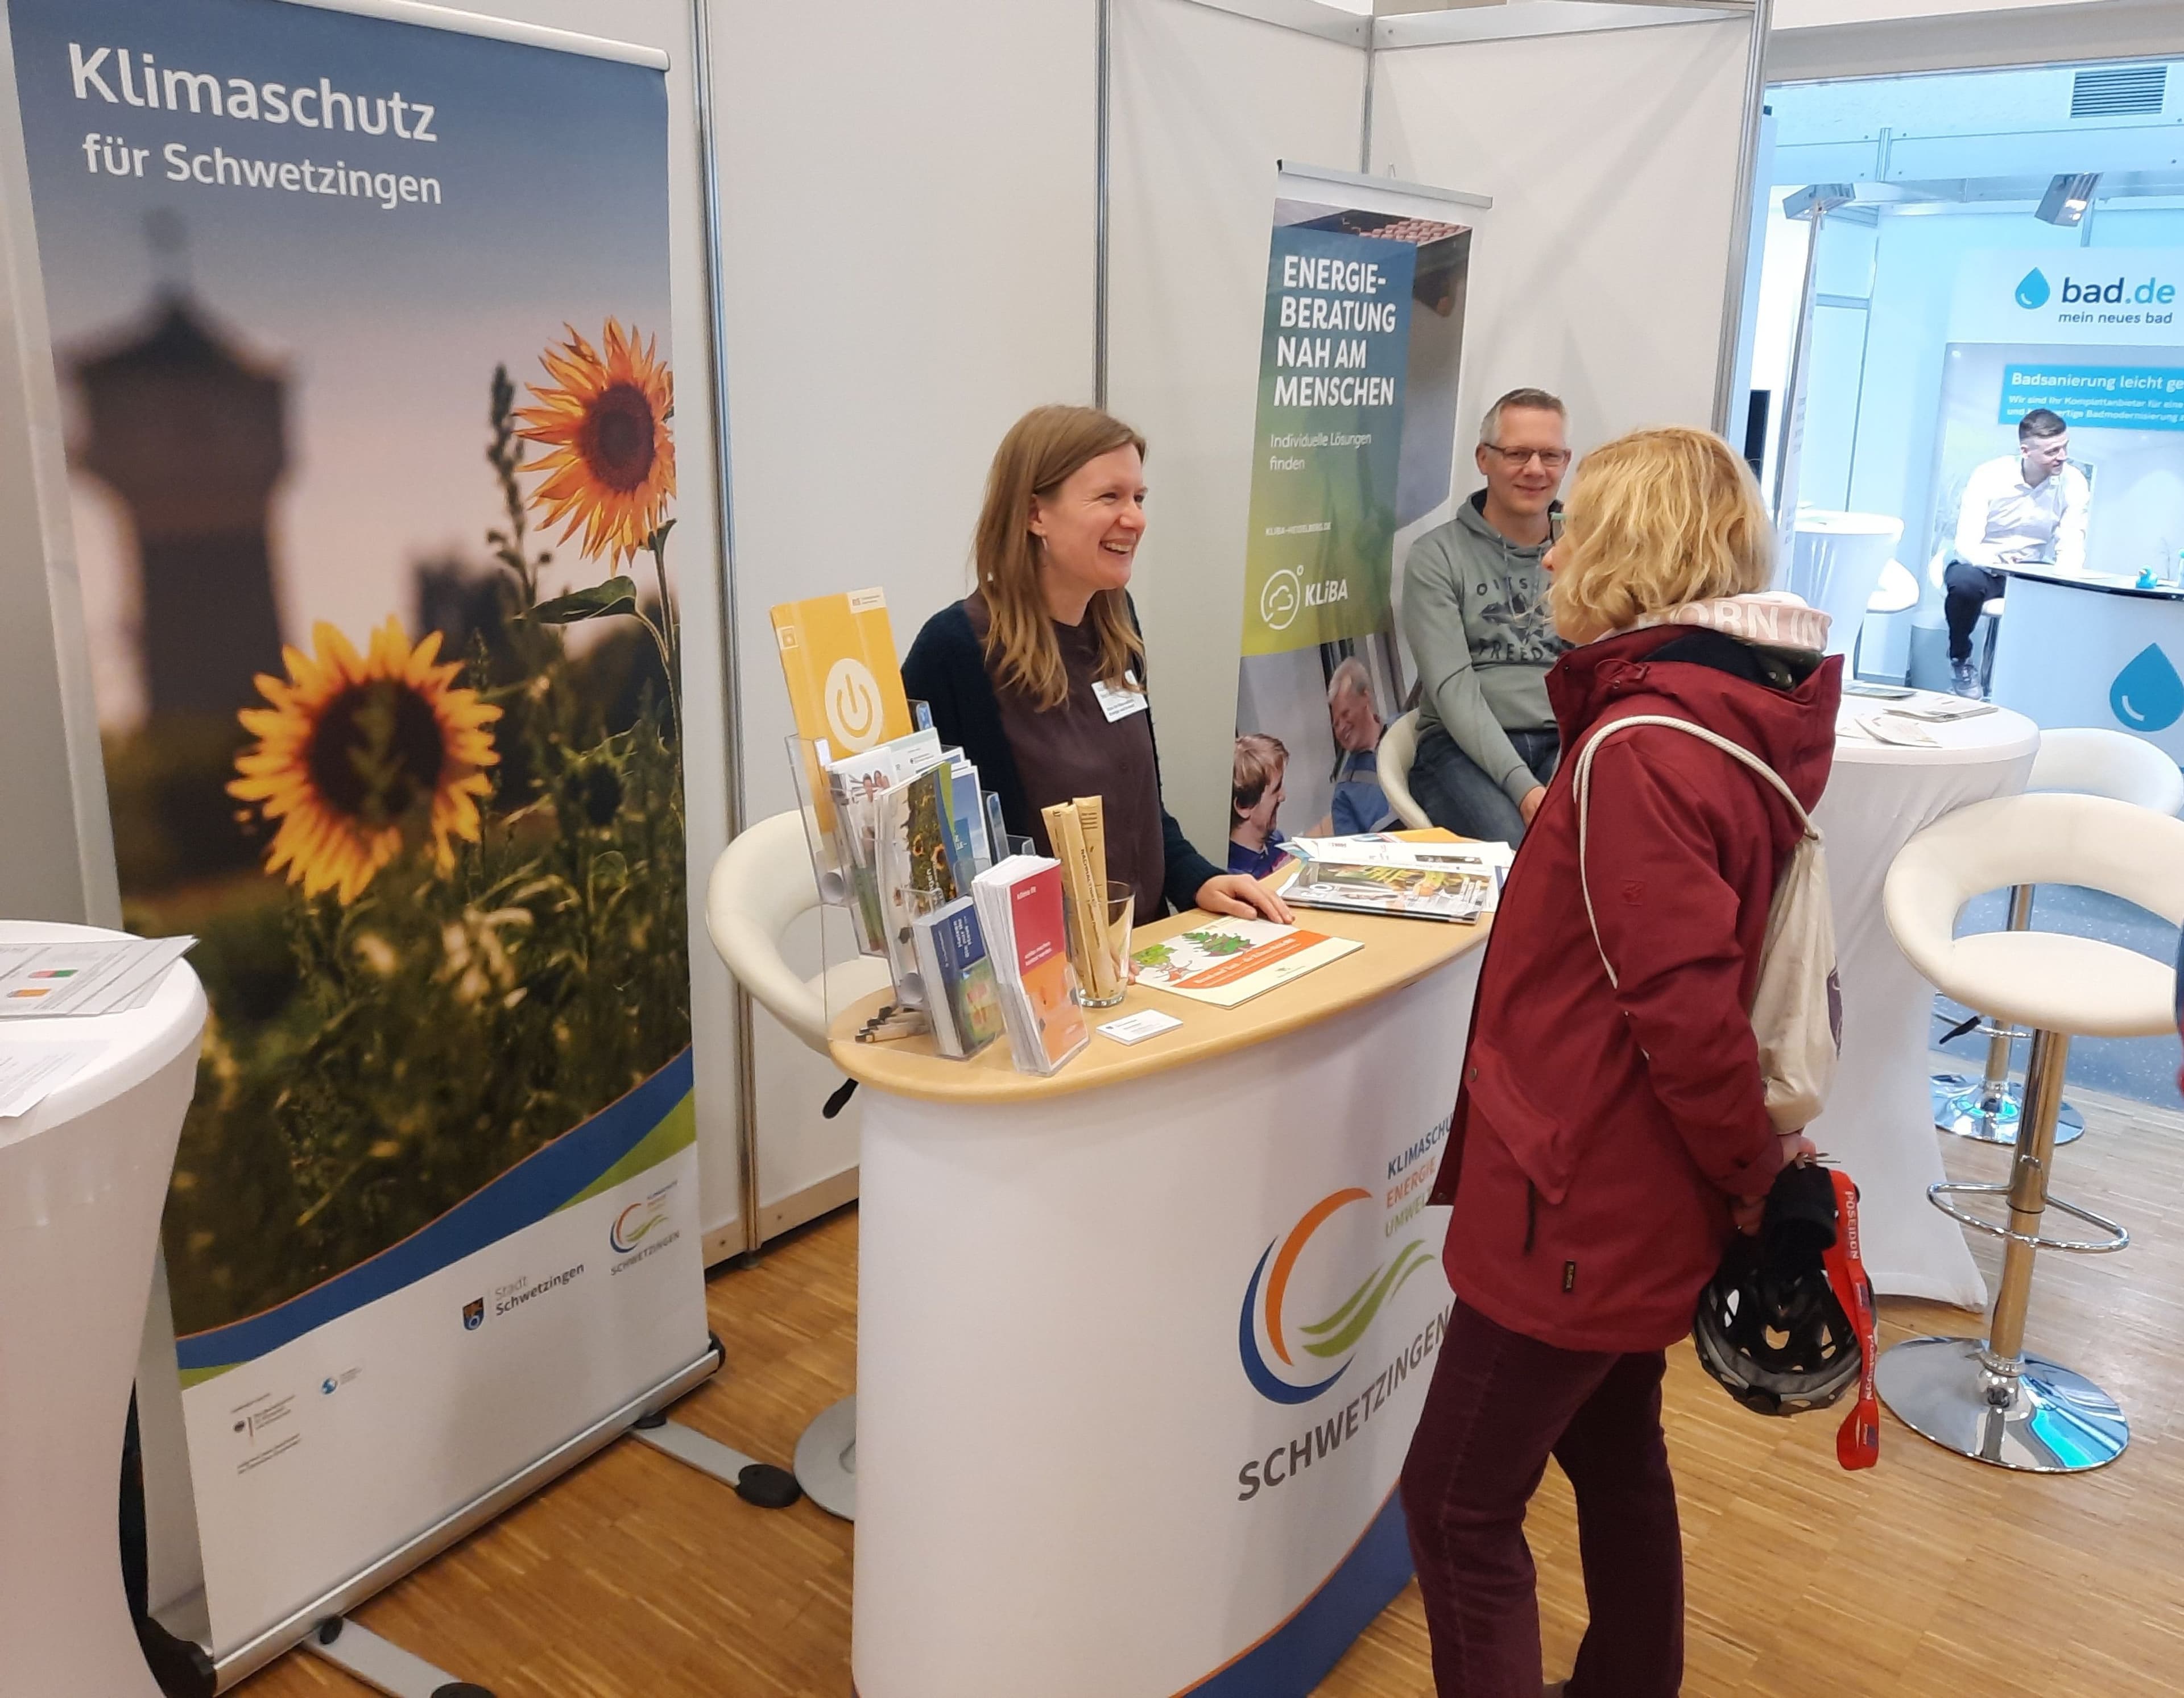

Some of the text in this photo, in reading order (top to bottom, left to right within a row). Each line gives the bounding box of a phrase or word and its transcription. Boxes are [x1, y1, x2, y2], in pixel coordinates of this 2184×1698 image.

[69, 43, 438, 142] Klimaschutz
[82, 133, 442, 209] für Schwetzingen
[1283, 255, 1387, 295] ENERGIE-
[2061, 276, 2175, 304] bad.de
[1280, 296, 1396, 333] BERATUNG
[2058, 312, 2173, 324] mein neues bad
[1277, 336, 1367, 369] NAH AM
[1273, 375, 1395, 406] MENSCHEN
[2012, 373, 2116, 391] Badsanierung
[2120, 375, 2164, 389] leicht
[1271, 433, 1328, 448] Individuelle
[1269, 456, 1305, 470] finden
[1387, 1156, 1437, 1209] ENERGIE
[1845, 1191, 1859, 1259] POSEIDON
[610, 1230, 681, 1276] SCHWETZINGEN
[495, 1276, 527, 1302] Stadt
[496, 1264, 585, 1316] Schwetzingen
[1238, 1304, 1450, 1502] SCHWETZINGEN
